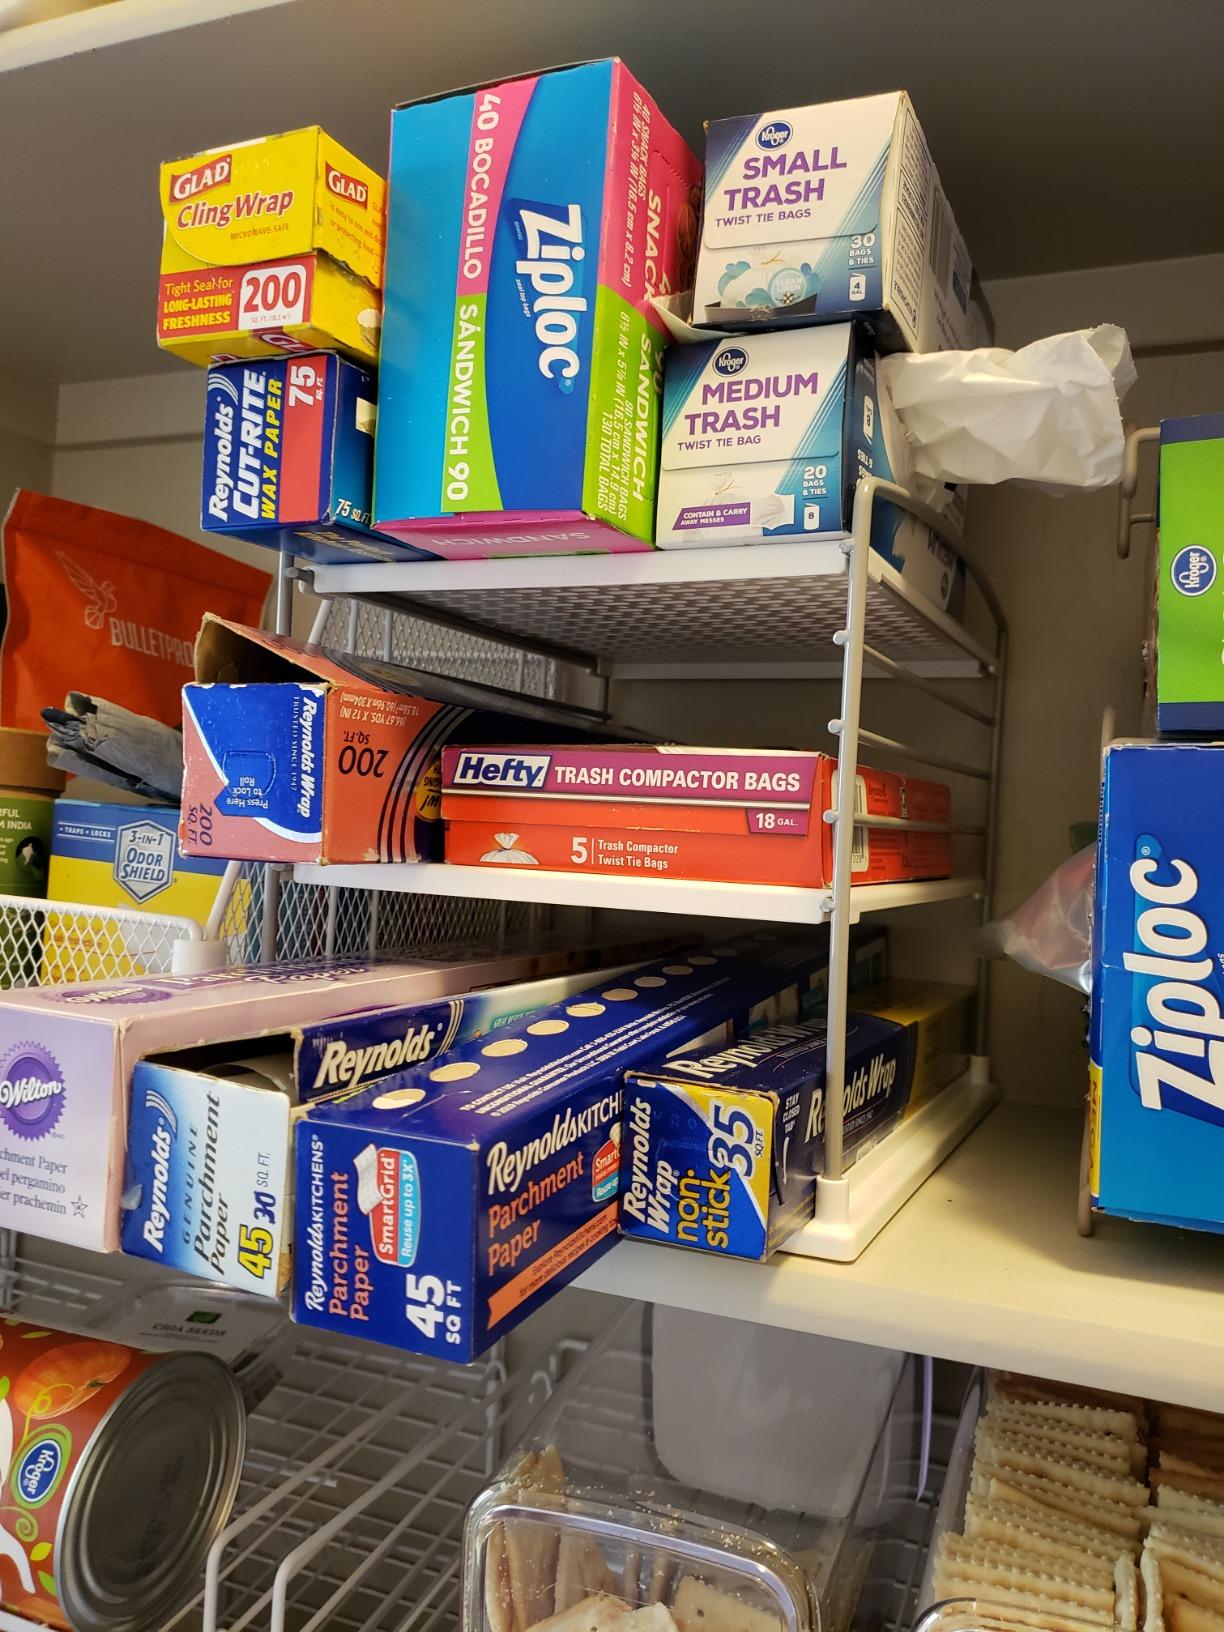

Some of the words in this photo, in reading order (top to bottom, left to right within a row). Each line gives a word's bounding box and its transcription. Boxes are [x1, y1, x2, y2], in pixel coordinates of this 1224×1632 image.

[477, 94, 501, 131] 40
[640, 121, 650, 166] SNACK
[760, 124, 790, 147] Kroger
[173, 158, 230, 199] GLAD
[742, 147, 847, 180] SMALL
[327, 169, 368, 203] GLAD
[637, 164, 648, 201] BAGS
[724, 178, 825, 211] TRASH
[177, 202, 233, 230] Cling
[235, 190, 294, 218] Wrap
[463, 137, 494, 280] BOCADILLO
[626, 211, 634, 231] cm
[715, 214, 752, 228] TWIST
[756, 212, 775, 224] TIE
[778, 208, 812, 221] BAGS
[230, 222, 290, 241] MICROWAVE-SAFE
[644, 189, 661, 301] SNACK
[850, 232, 876, 249] 30
[624, 242, 634, 264] 8.2
[849, 248, 872, 257] BAGS
[165, 281, 191, 297] Tight
[194, 277, 215, 293] Seal
[217, 278, 233, 290] for
[243, 271, 301, 313] 200
[515, 204, 587, 379] Ziploc
[854, 281, 861, 290] 4
[163, 293, 232, 313] LONG-LASTING
[162, 311, 231, 331] FRESHNESS
[618, 334, 629, 349] IN
[718, 353, 745, 374] Kroger
[288, 365, 316, 407] 75
[450, 304, 478, 455] SANDWICH
[615, 382, 626, 397] IN
[702, 372, 818, 405] MEDIUM
[264, 378, 283, 458] PAPER
[601, 411, 613, 436] 130
[624, 399, 634, 419] 90
[633, 333, 651, 501] SANDWICH
[684, 405, 780, 436] TRASH
[233, 369, 266, 519] CUT-RITE
[599, 437, 611, 472] TOTAL
[612, 432, 620, 449] cm
[621, 418, 633, 486] SANDWICH
[678, 439, 712, 451] TWIST
[716, 437, 733, 447] TIE
[737, 434, 762, 446] BAG
[208, 402, 234, 522] Reynolds
[803, 465, 827, 480] 20
[261, 464, 279, 519] WAX
[446, 463, 470, 501] 90
[597, 475, 609, 511] BAGS
[610, 465, 620, 492] 14.9
[803, 479, 824, 488] BAGS
[810, 487, 826, 496] TIES
[336, 498, 352, 517] 75
[608, 492, 617, 515] cm)
[618, 486, 629, 521] BAGS
[684, 509, 715, 519] CONTAIN
[722, 507, 748, 517] CARRY
[808, 511, 815, 520] 8
[680, 518, 699, 526] AWAY
[700, 516, 725, 525] MESSES
[431, 531, 592, 547] SANDWICH
[1182, 551, 1206, 588] Kroger
[352, 708, 361, 720] 12
[362, 711, 369, 721] X
[299, 697, 317, 773] Reynolds
[338, 745, 391, 778] 200
[460, 757, 544, 787] Hefty
[231, 786, 252, 796] Lock
[239, 776, 255, 786] Roll
[254, 787, 263, 796] to
[555, 767, 614, 785] TRASH
[619, 768, 739, 790] COMPACTOR
[744, 772, 800, 792] BAGS
[226, 797, 246, 808] Here
[246, 798, 269, 809] Press
[300, 773, 315, 818] Wrap
[7, 822, 32, 830] INDIA
[65, 826, 84, 835] TRAPS
[90, 829, 111, 838] LOCKS
[199, 800, 213, 846] 200
[755, 813, 775, 829] 18
[129, 830, 163, 846] 3-IN-1
[570, 837, 588, 864] 5
[598, 839, 624, 851] Trash
[626, 841, 679, 855] Compactor
[120, 863, 165, 882] SHIELD
[126, 848, 163, 867] ODOR
[598, 854, 624, 866] Twist
[626, 856, 641, 867] Tie
[644, 856, 668, 870] Bags
[1123, 858, 1224, 1111] Ziploc
[313, 1023, 436, 1088] Reynolds
[661, 1036, 797, 1079] Reynolds
[867, 1053, 897, 1101] Wrap
[0, 1077, 62, 1109] Wilton
[785, 1092, 800, 1109] STAY
[783, 1105, 800, 1124] CLOSED
[708, 1099, 757, 1181] 35
[38, 1156, 68, 1174] Paper
[623, 1097, 651, 1222] Reynolds
[11, 1173, 66, 1193] pergamino
[143, 1125, 171, 1253] Reynolds
[183, 1127, 199, 1245] GENUINE
[194, 1090, 221, 1261] Parchment
[403, 1183, 414, 1197] to
[254, 1190, 277, 1224] 30
[379, 1154, 395, 1255] SmartGrid
[404, 1199, 415, 1217] up
[488, 1151, 584, 1238] Parchment
[646, 1160, 674, 1234] Wrap
[700, 1168, 732, 1248] stick
[206, 1193, 229, 1275] Paper
[329, 1171, 349, 1316] Parchment
[401, 1219, 412, 1257] Reuse
[488, 1218, 541, 1276] Paper
[237, 1224, 274, 1280] 45
[350, 1244, 373, 1321] Paper
[446, 1280, 463, 1309] FT
[406, 1274, 444, 1339] 45
[152, 1323, 184, 1332] CHIA
[186, 1327, 226, 1336] SEEDS
[446, 1312, 461, 1344] SQ
[25, 1449, 54, 1495] Kroger
